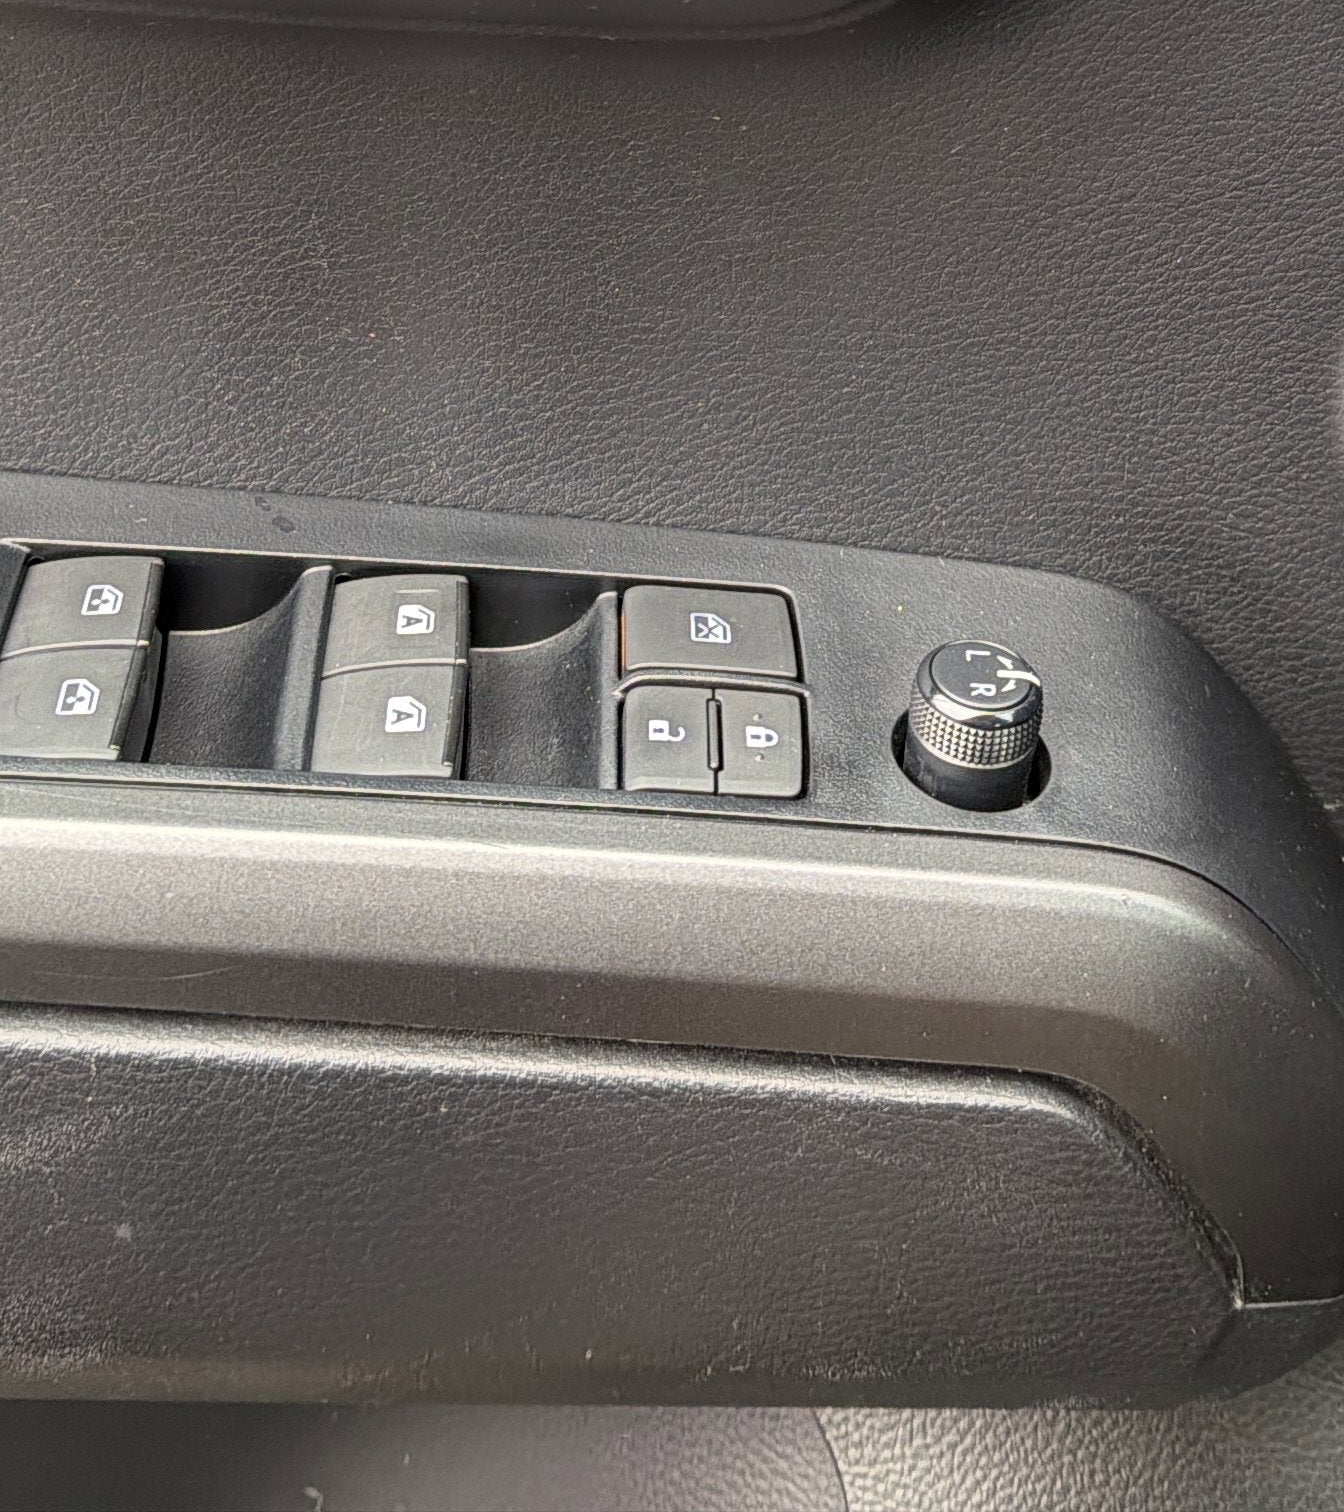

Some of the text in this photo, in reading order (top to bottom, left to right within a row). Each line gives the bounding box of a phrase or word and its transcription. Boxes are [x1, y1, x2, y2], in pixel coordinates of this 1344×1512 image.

[400, 614, 424, 629] A
[965, 649, 997, 697] L R
[390, 708, 415, 726] A
